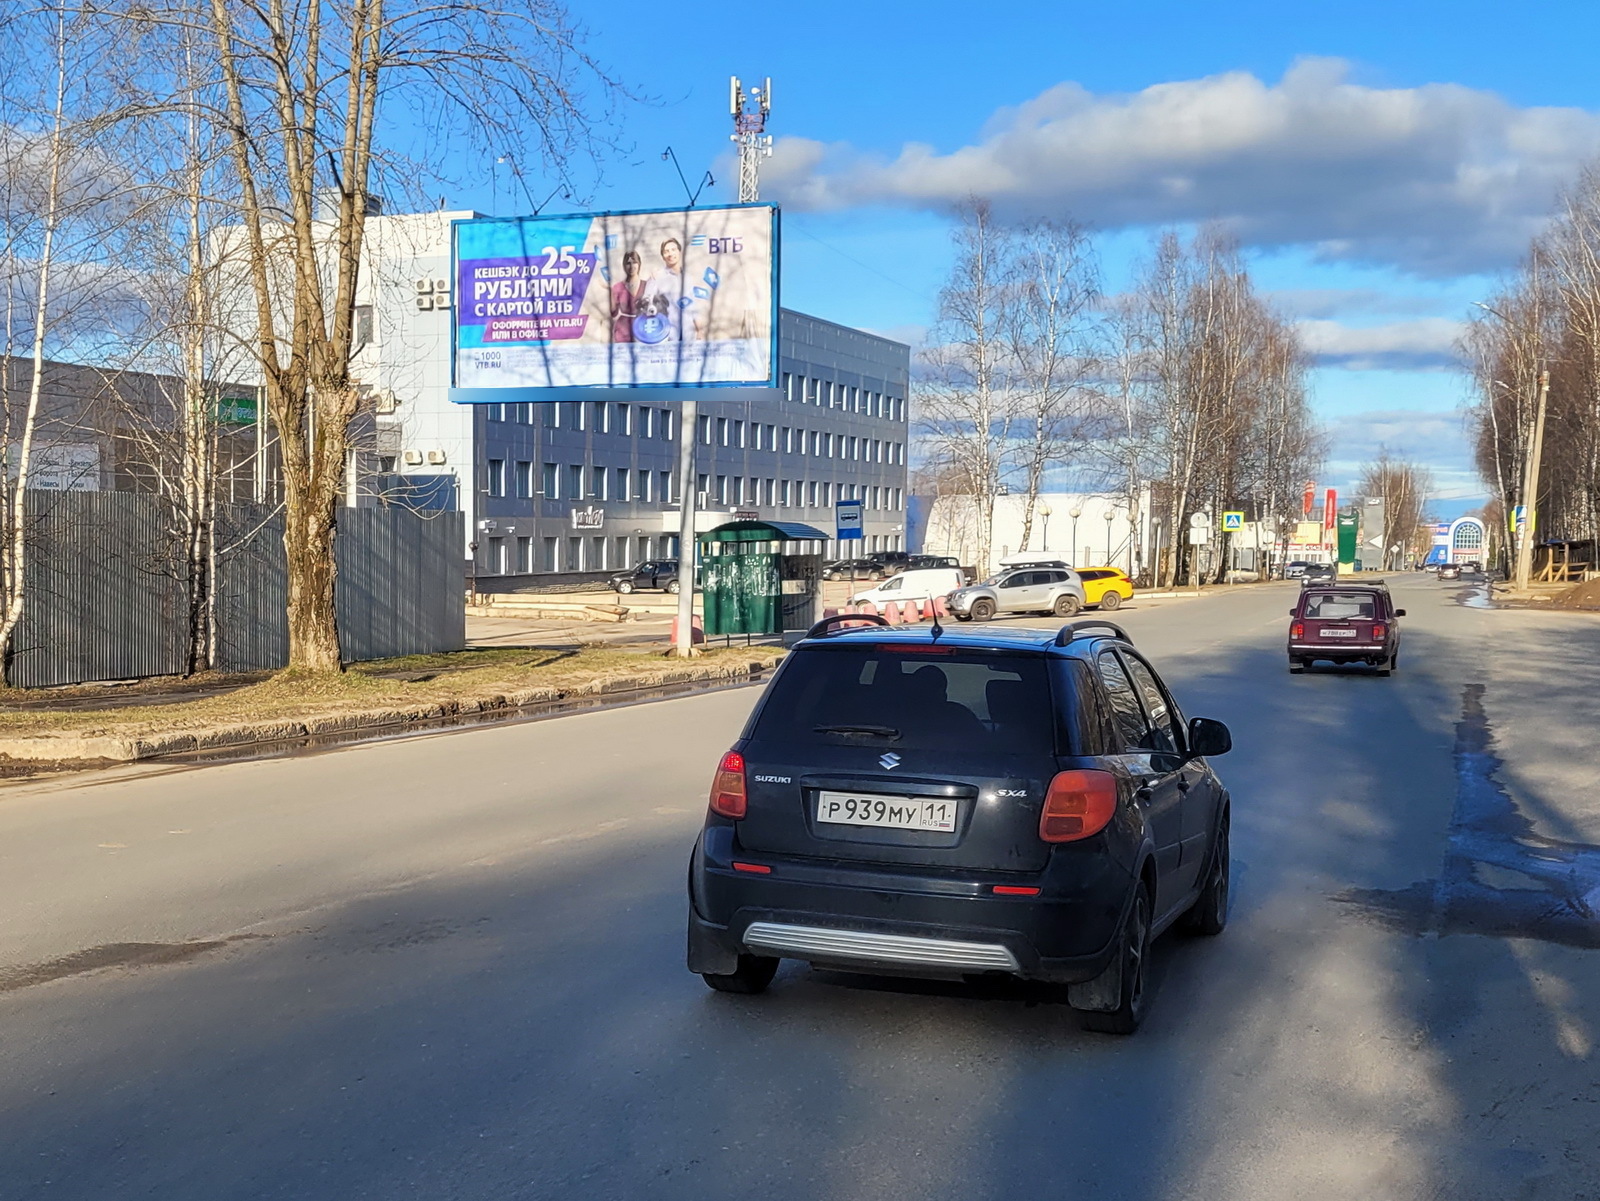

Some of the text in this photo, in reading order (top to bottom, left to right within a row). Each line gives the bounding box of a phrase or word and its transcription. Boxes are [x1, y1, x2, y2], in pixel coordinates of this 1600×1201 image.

[709, 237, 743, 254] ВТБ
[474, 245, 590, 279] КЕШБЭК ДО 25%
[474, 278, 573, 300] РУБЛЯМИ
[474, 299, 573, 317] С КАРТОЙ ВТБ
[492, 318, 583, 330] ОФОРМИТЕ НА VTB.RU
[492, 329, 549, 340] ИЛИ В ОФИСЕ
[481, 351, 501, 360] 1000
[475, 361, 501, 369] VTB.RU
[754, 774, 792, 784] SUZUKI
[994, 788, 1028, 798] SX4
[827, 798, 948, 825] Р939МУ 11
[921, 819, 938, 827] RUS
